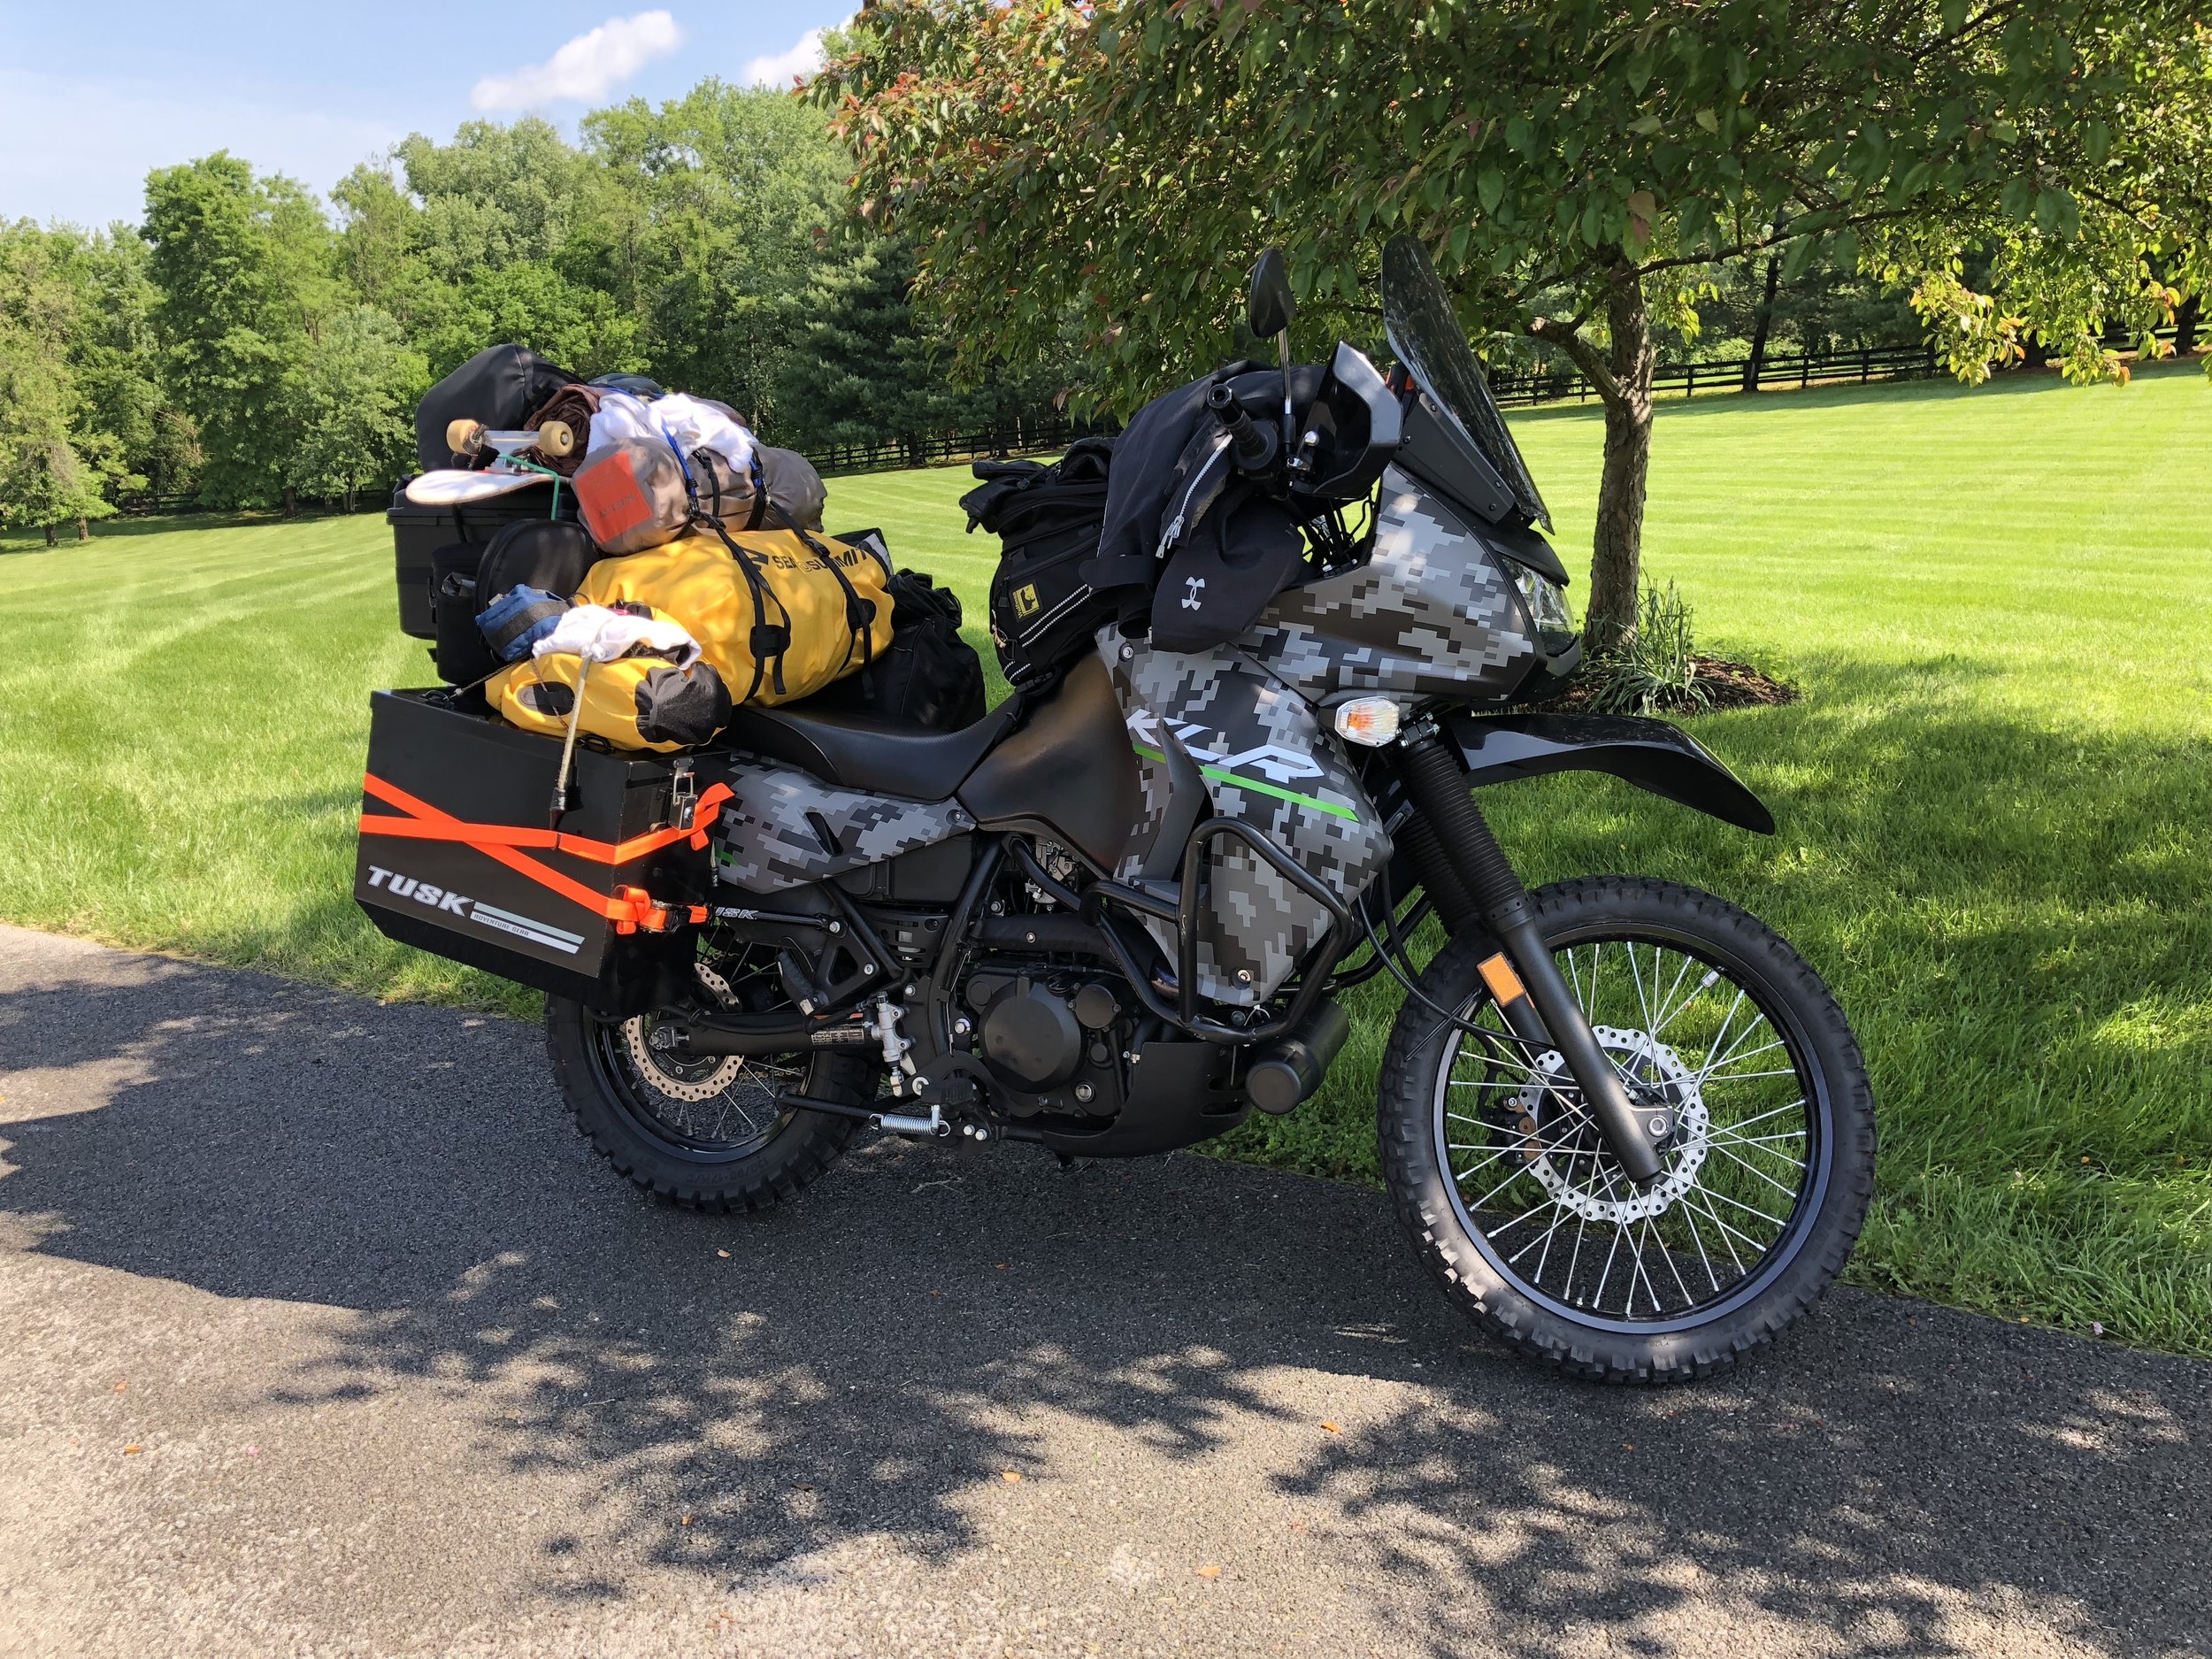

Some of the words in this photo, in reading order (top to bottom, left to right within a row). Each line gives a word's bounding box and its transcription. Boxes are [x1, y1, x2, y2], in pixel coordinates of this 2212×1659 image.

[772, 555, 797, 571] SEA
[1125, 708, 1325, 785] KLR
[367, 864, 475, 918] TUSK
[472, 913, 511, 930] ADVENTURE
[511, 926, 530, 937] GEAR
